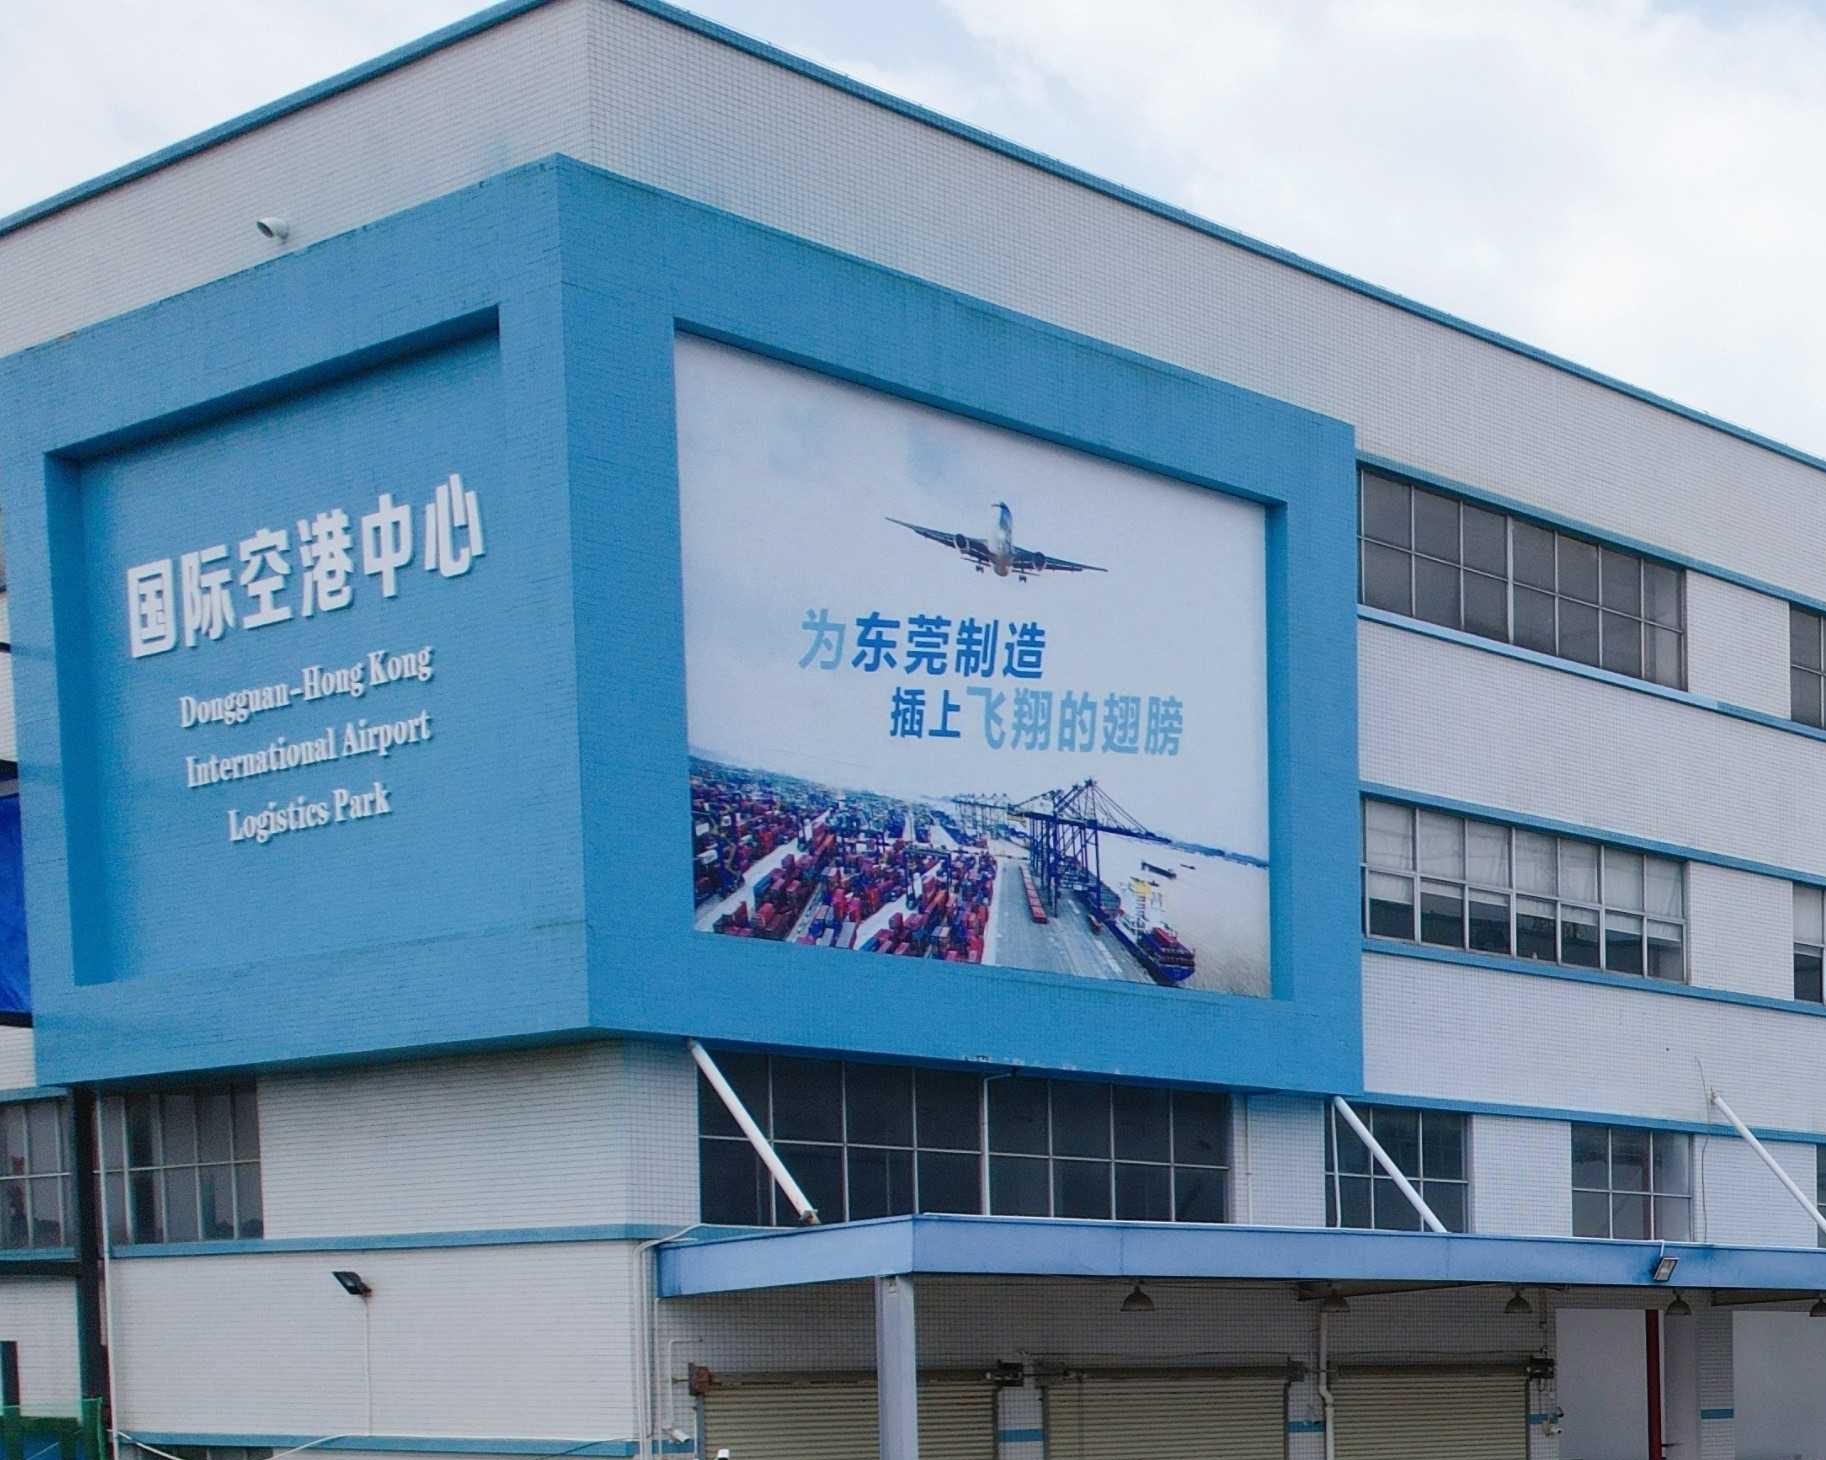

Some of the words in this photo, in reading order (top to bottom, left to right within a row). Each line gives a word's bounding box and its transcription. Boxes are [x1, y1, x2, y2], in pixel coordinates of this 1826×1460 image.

[127, 474, 485, 658] 国际空港中心
[369, 647, 433, 684] Kong
[798, 608, 1047, 680] 为东莞制造
[186, 727, 336, 788] International
[343, 710, 432, 759] Airport
[890, 685, 1184, 757] 插上飞翔的翅膀
[228, 795, 329, 843] Logistics
[333, 783, 391, 822] Park
